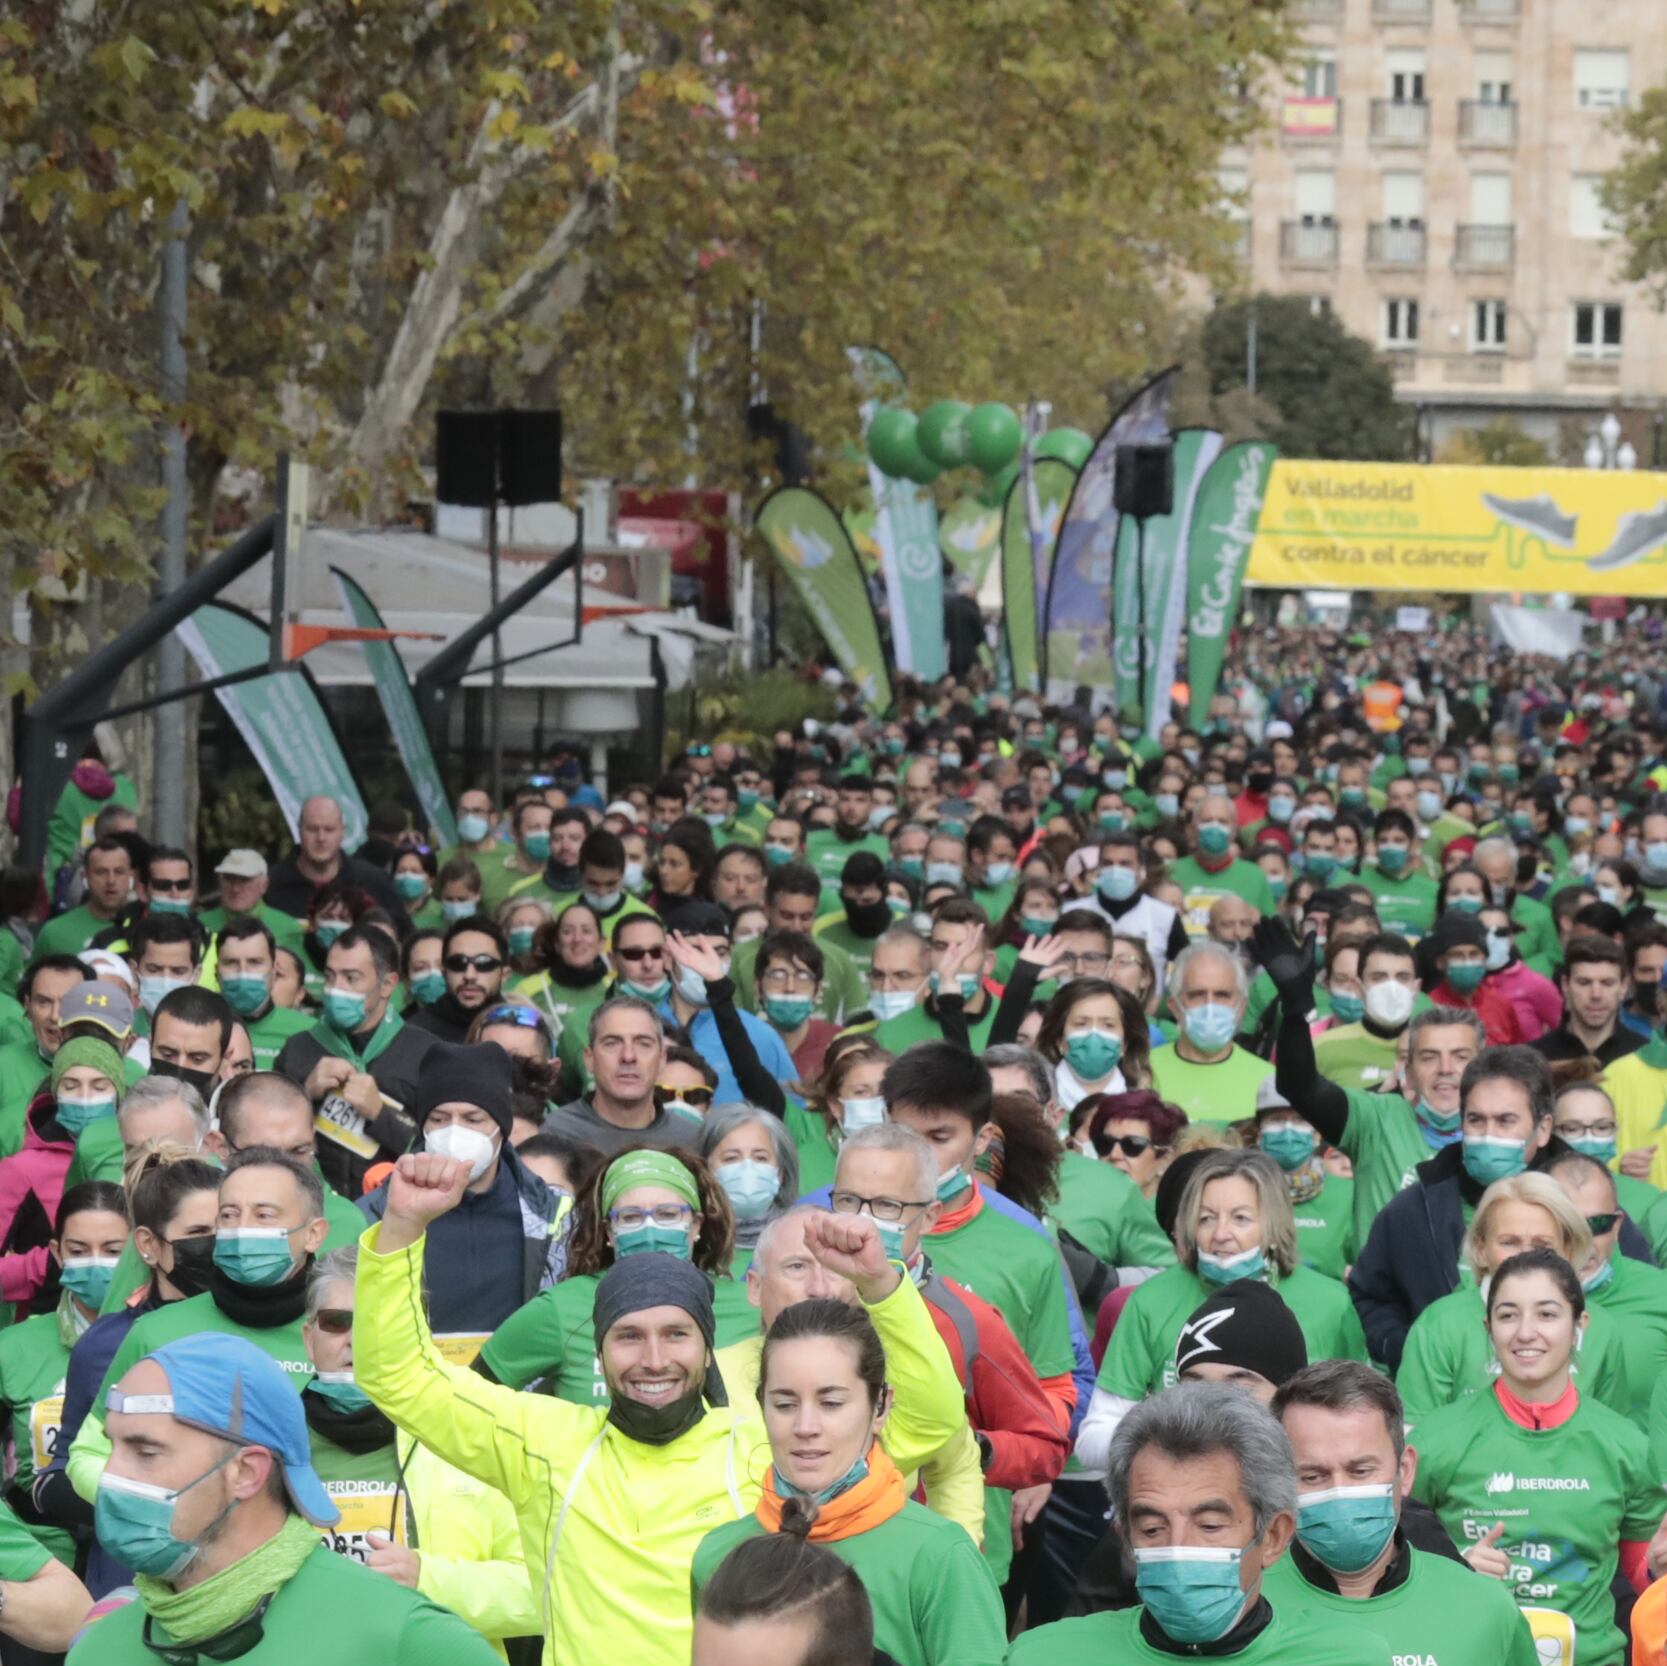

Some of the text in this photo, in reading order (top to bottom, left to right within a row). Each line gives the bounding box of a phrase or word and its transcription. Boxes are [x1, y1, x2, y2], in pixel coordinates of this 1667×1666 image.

[1284, 475, 1414, 503] Valladolid
[1284, 506, 1419, 531] en marcha
[1281, 540, 1489, 570] contra el cáncer
[1516, 1477, 1590, 1492] IBERDROLA
